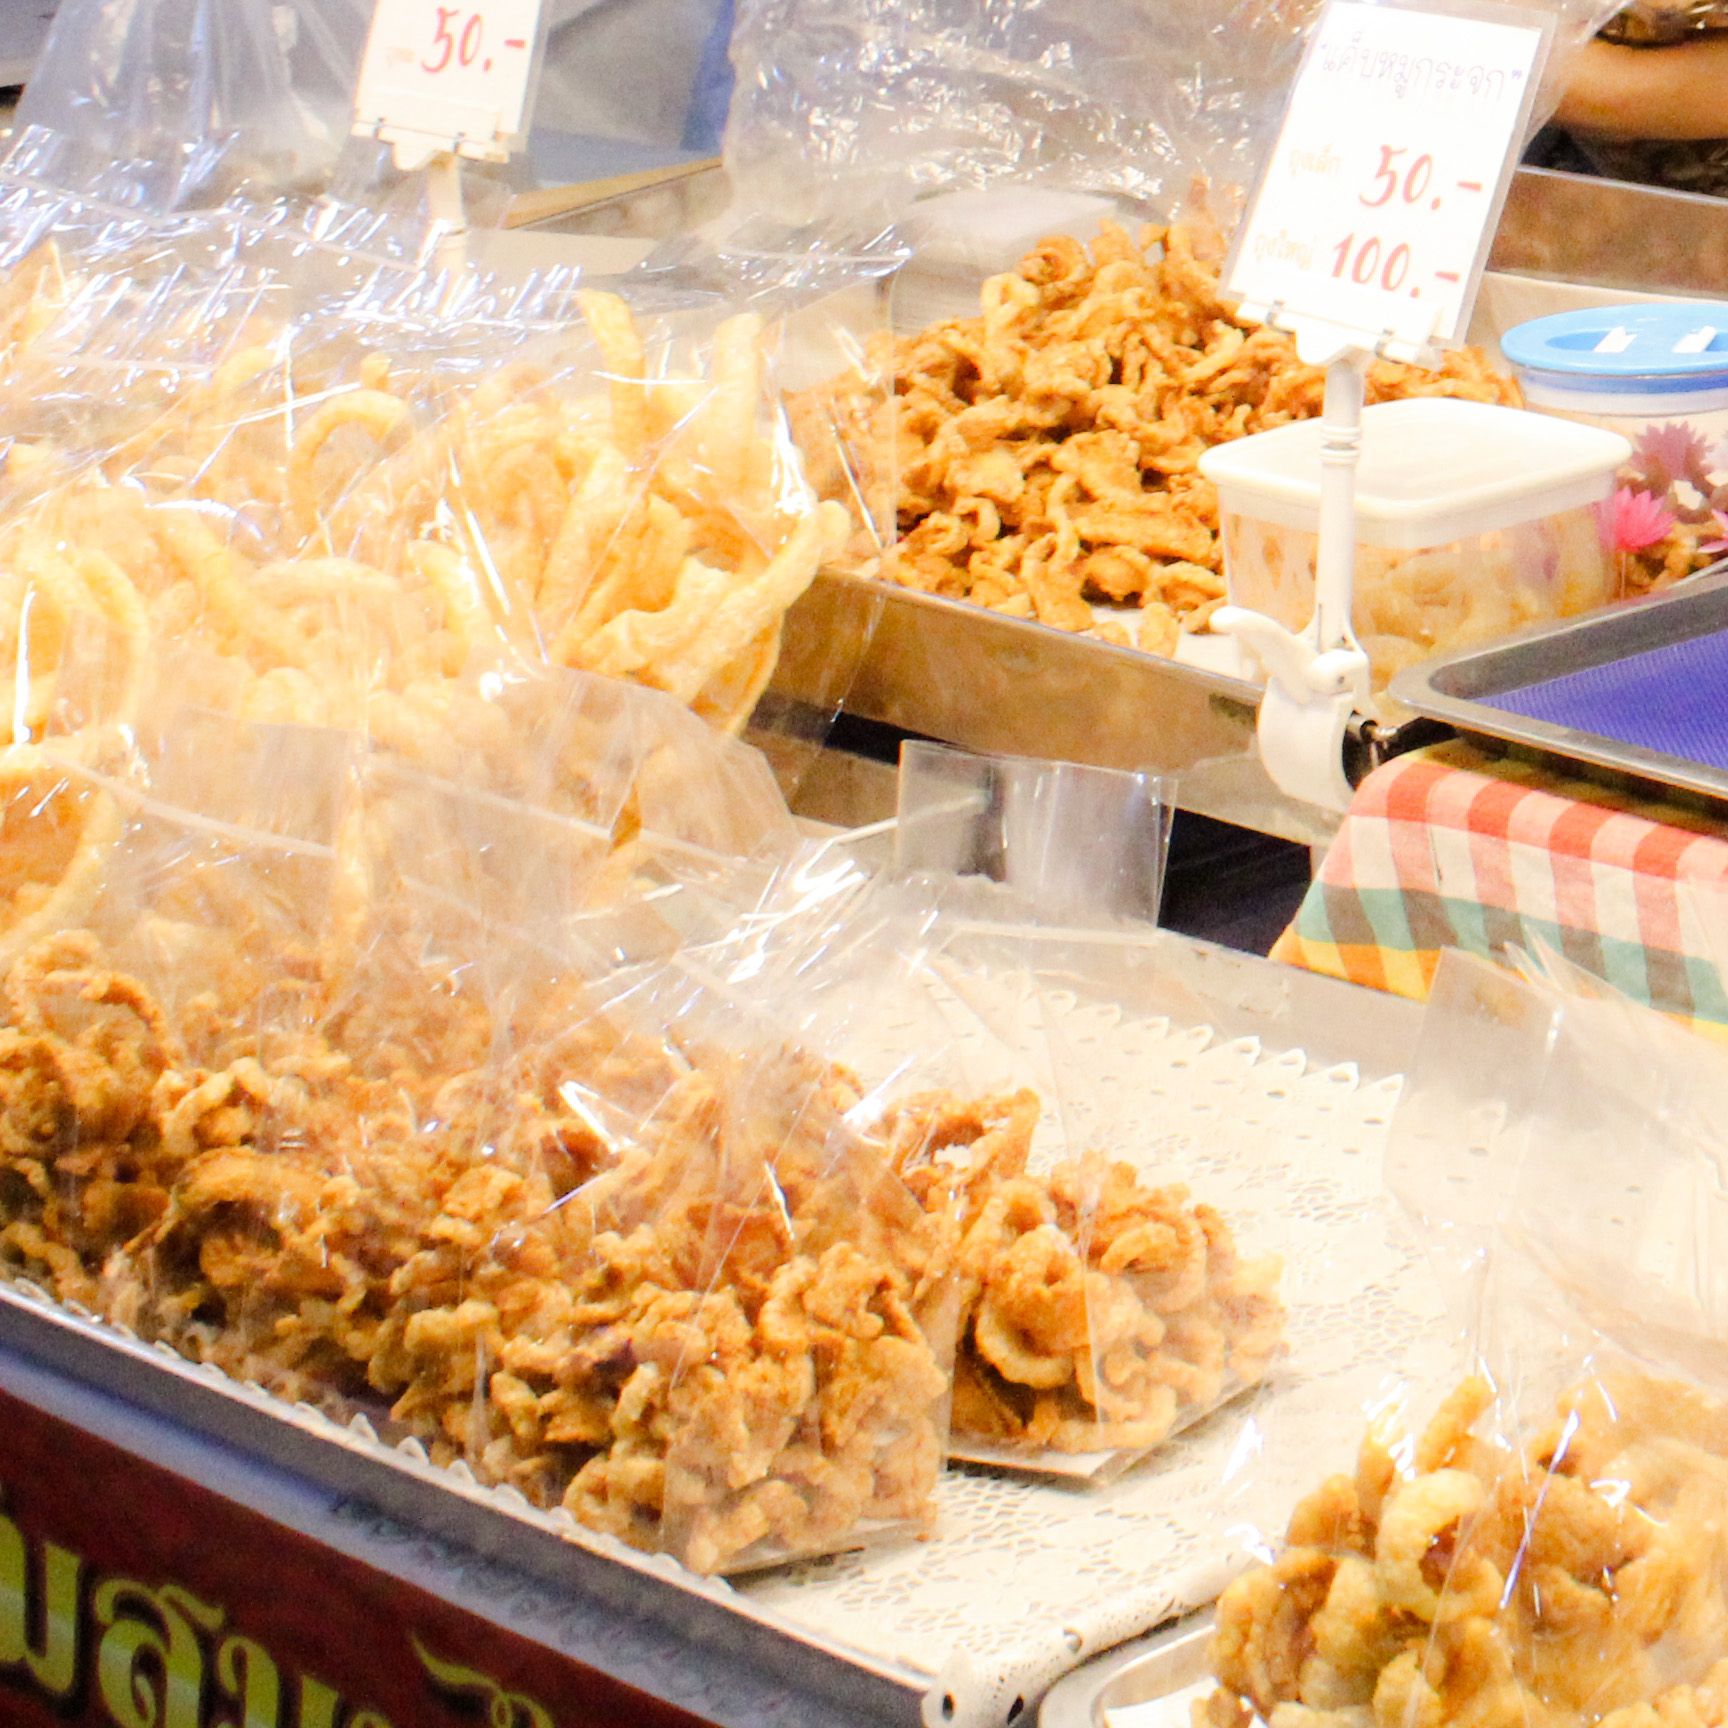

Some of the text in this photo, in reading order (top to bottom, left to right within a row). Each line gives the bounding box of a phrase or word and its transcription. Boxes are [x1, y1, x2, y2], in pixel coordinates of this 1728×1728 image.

[420, 6, 526, 73] 50.-
[1358, 144, 1483, 210] 50.-
[1331, 231, 1460, 299] 100.-
